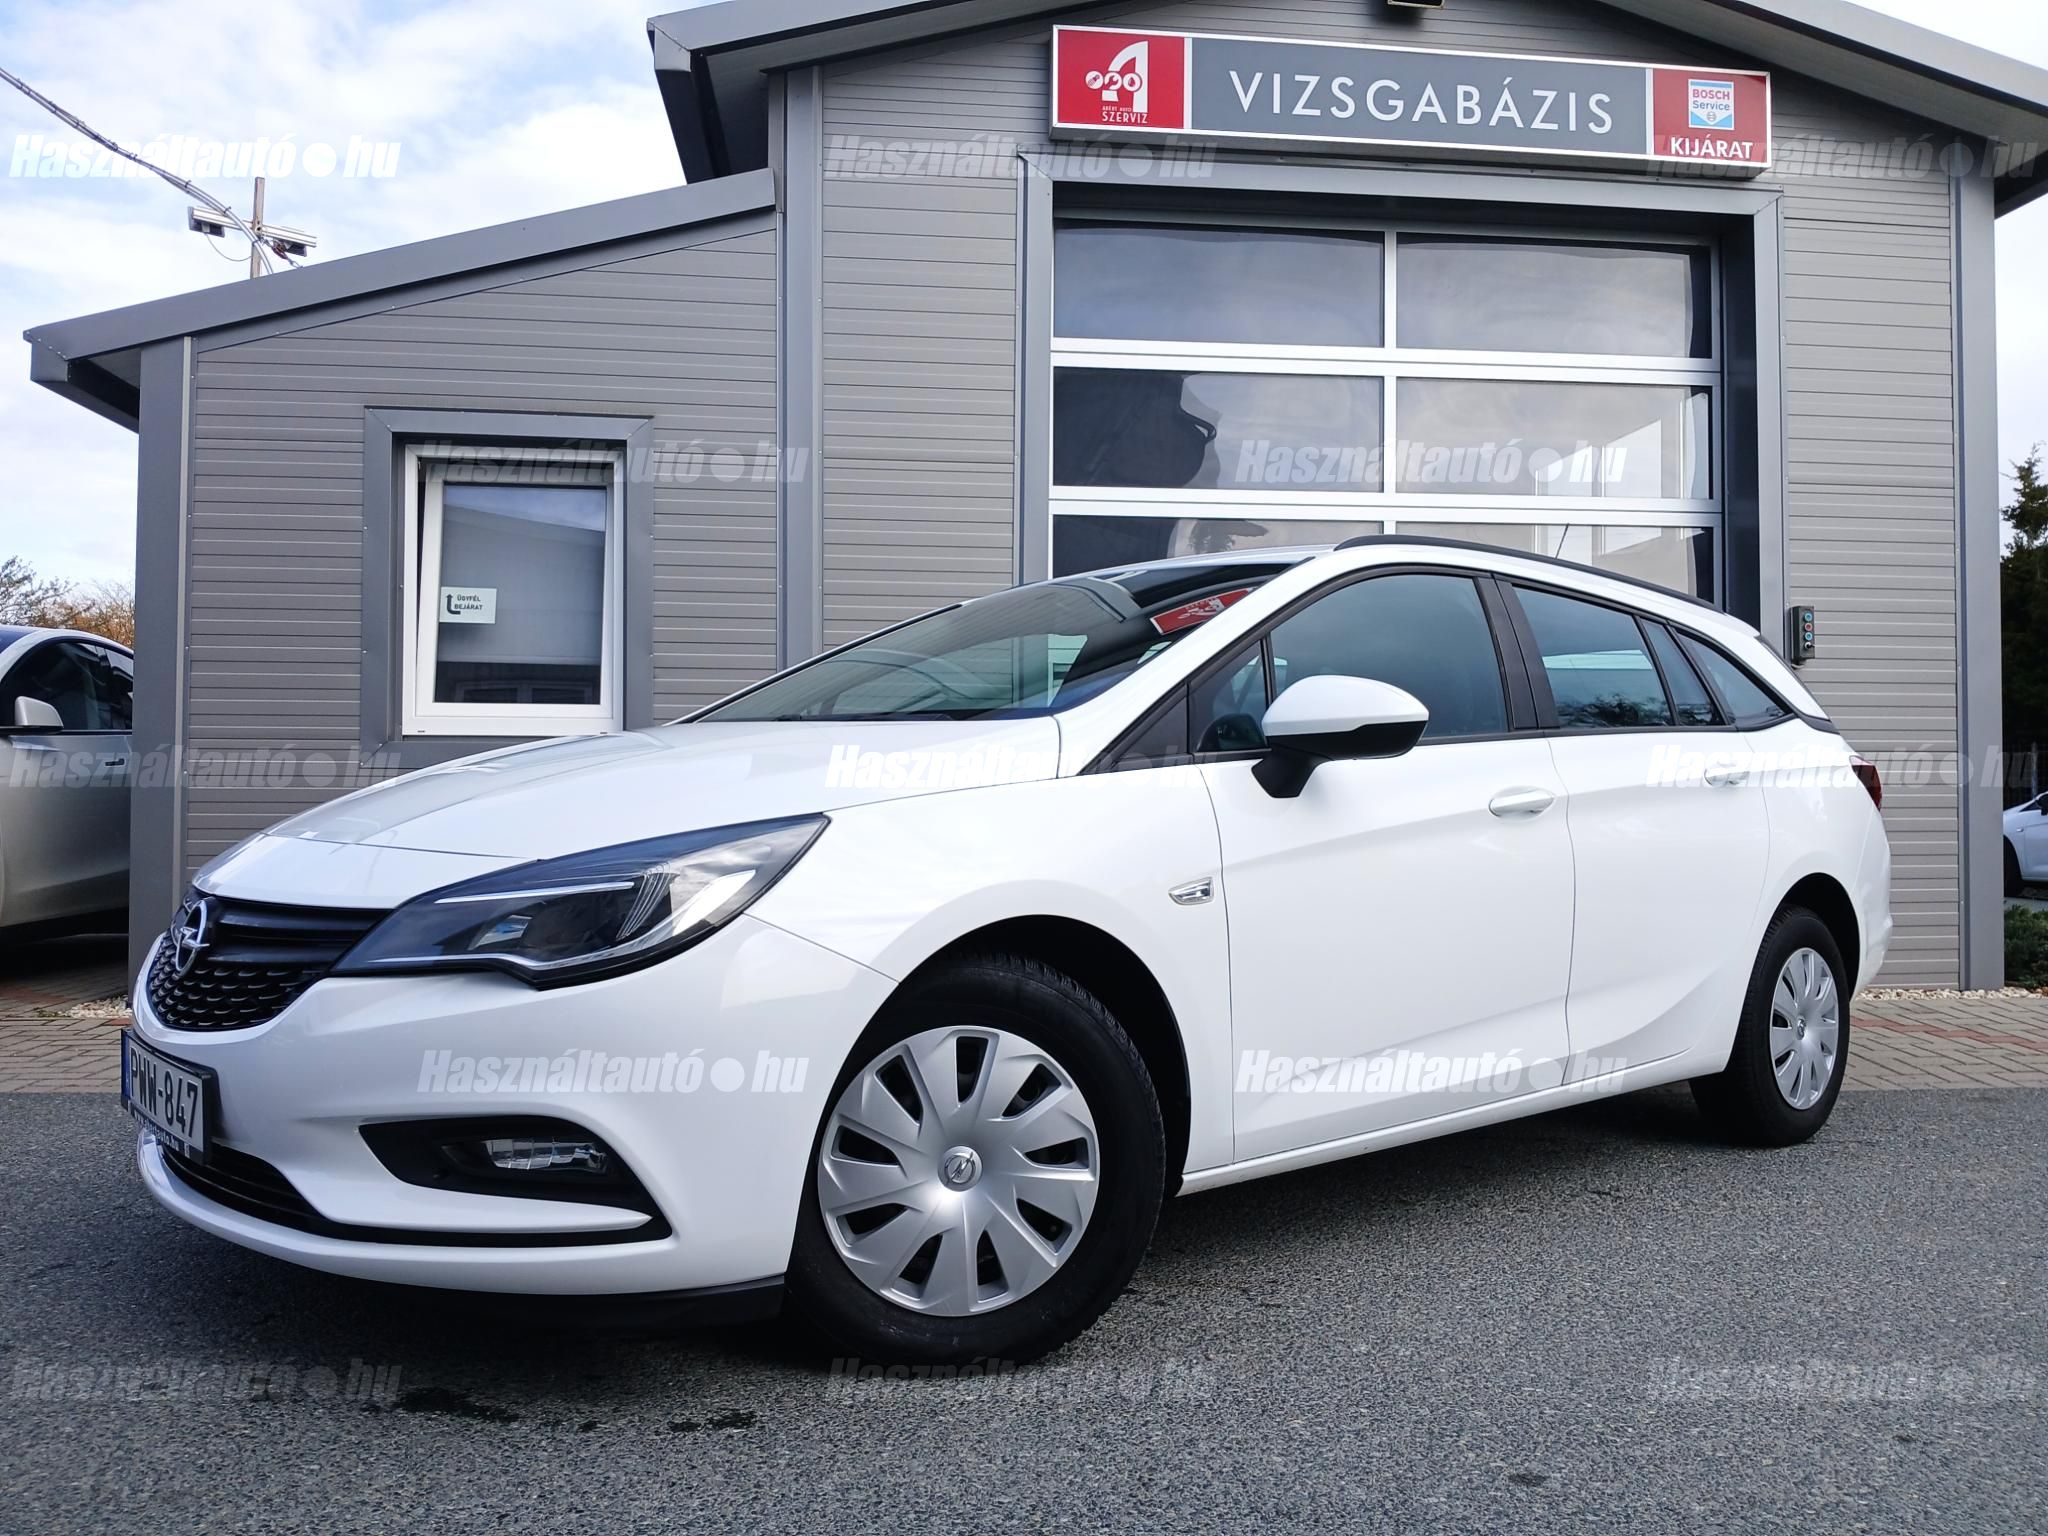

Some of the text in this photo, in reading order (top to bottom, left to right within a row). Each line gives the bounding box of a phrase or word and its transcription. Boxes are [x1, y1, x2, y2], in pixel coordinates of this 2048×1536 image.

[1692, 89, 1730, 100] BOSCH
[1228, 70, 1613, 135] VIZSGABÁZIS
[1692, 100, 1730, 110] Service
[1102, 111, 1148, 124] SZERVIZ
[1671, 134, 1753, 159] KIJÁRAT
